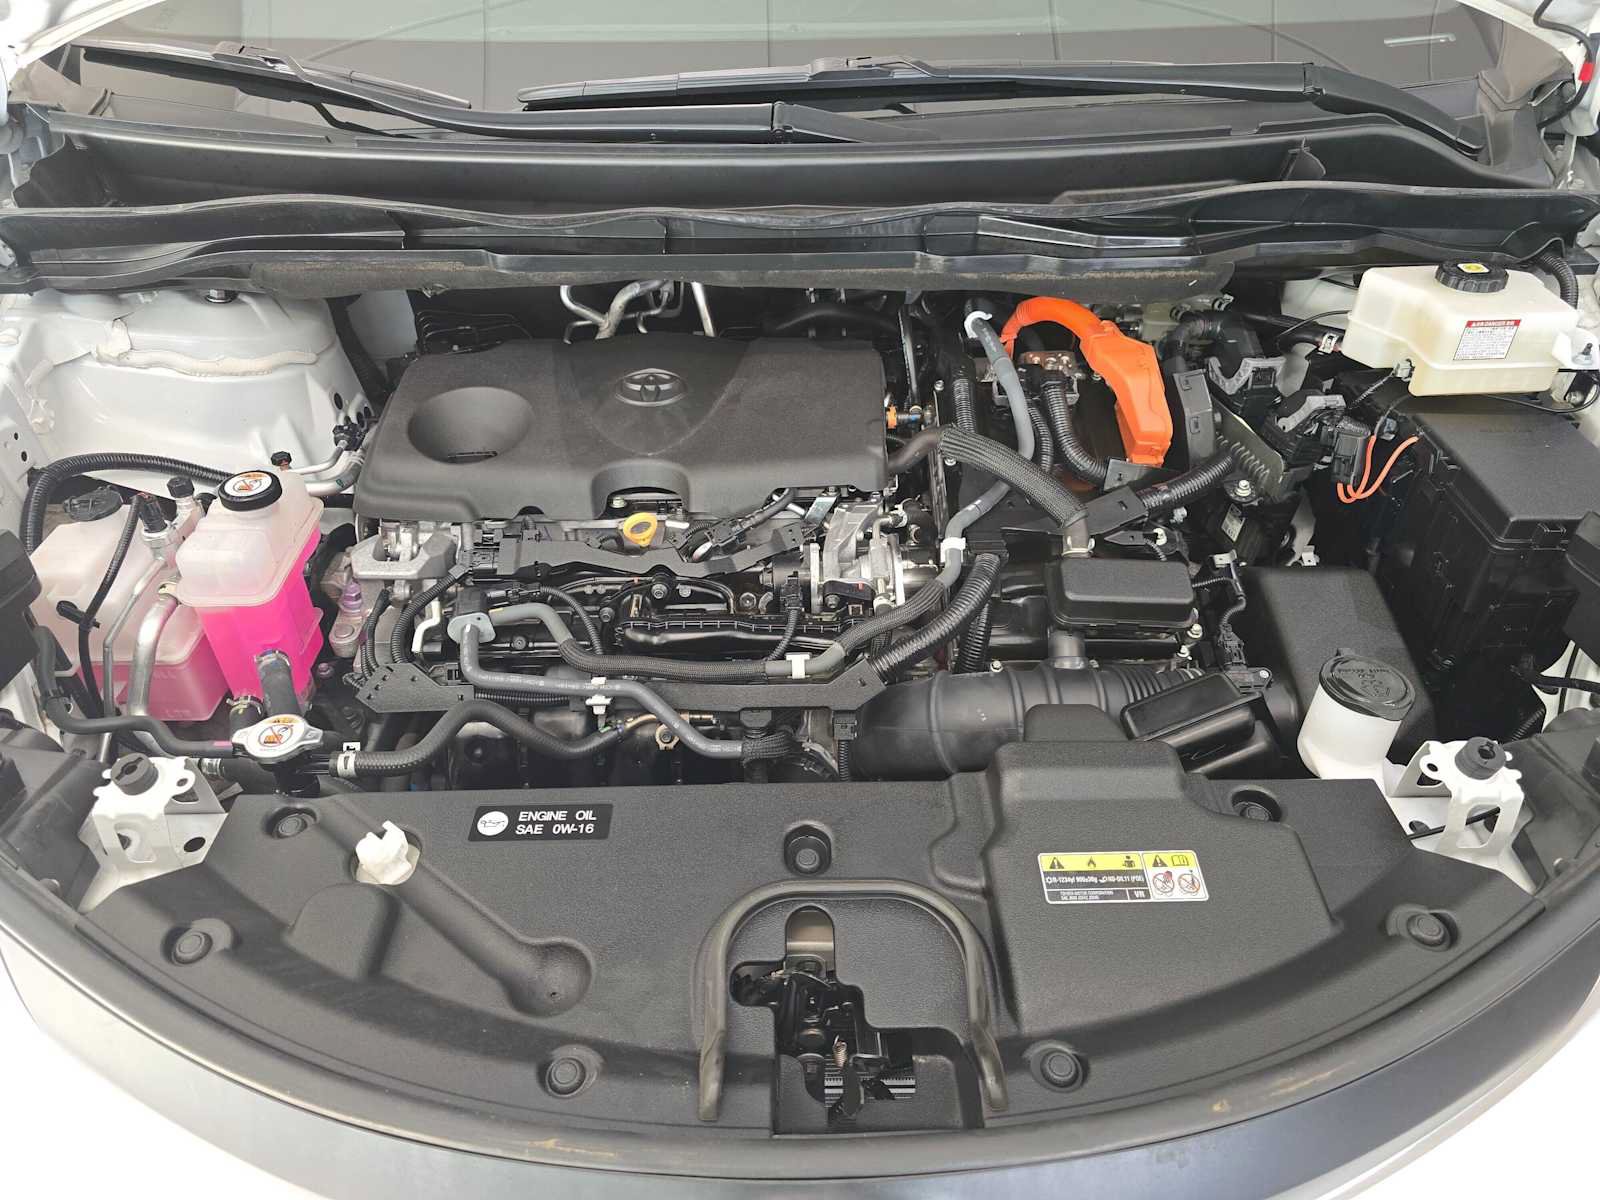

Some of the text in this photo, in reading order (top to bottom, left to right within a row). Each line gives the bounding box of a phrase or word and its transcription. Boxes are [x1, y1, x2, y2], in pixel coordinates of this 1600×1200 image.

[518, 810, 598, 821] ENGINE OIL
[515, 823, 594, 834] SAE 0W-16
